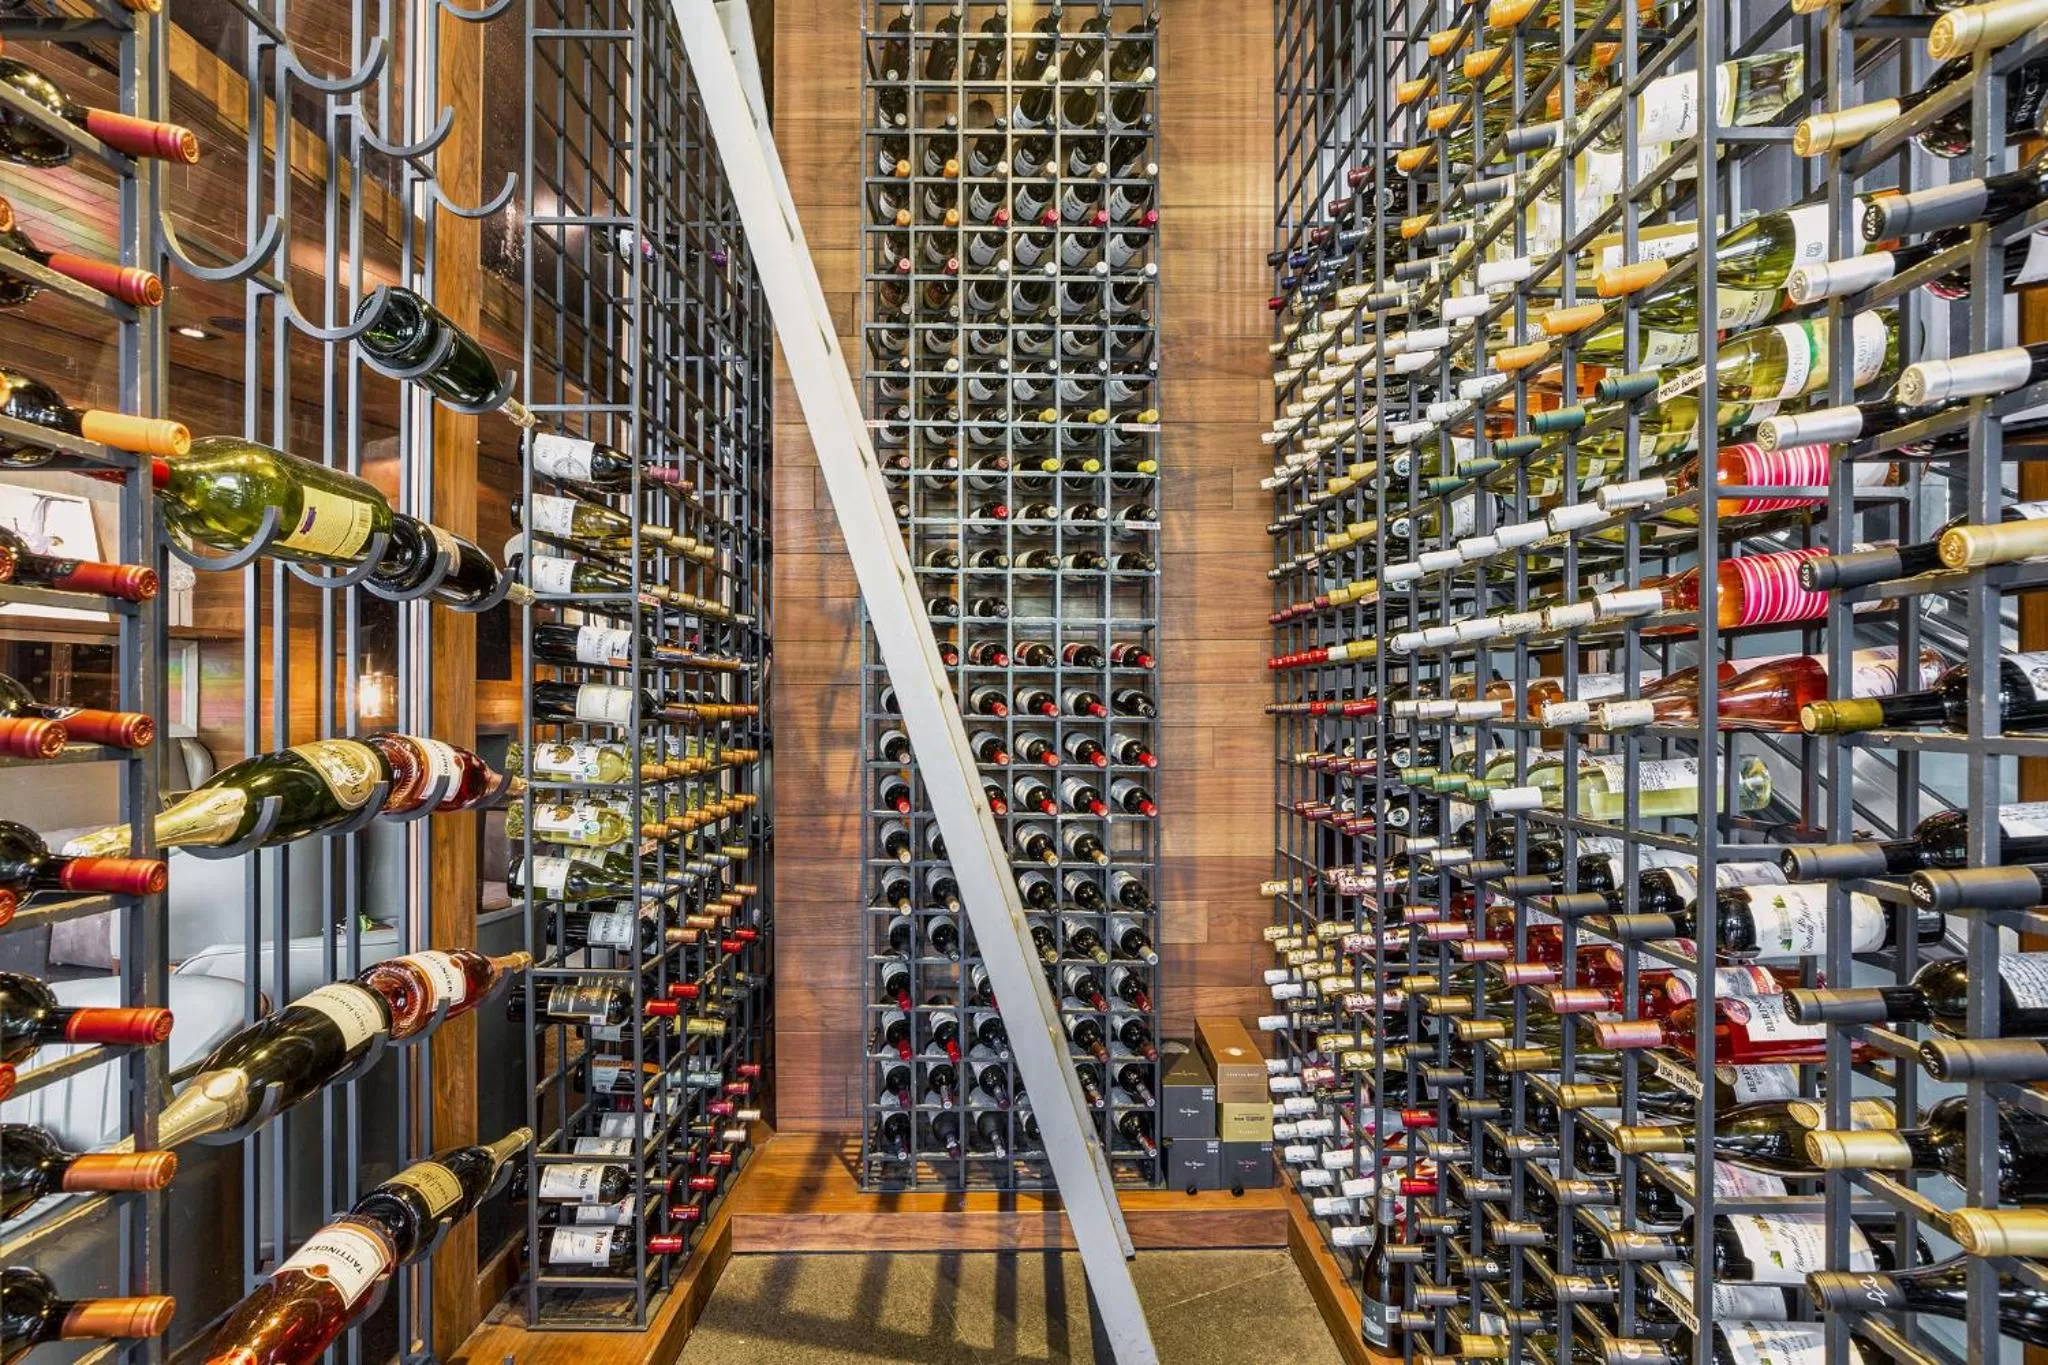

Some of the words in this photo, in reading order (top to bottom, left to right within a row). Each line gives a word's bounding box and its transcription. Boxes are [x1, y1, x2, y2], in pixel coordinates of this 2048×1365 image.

[1866, 206, 1877, 237] 1597
[1801, 563, 1811, 588] 1597
[1660, 1063, 1675, 1080] USA
[304, 1245, 364, 1274] TAITTINGER
